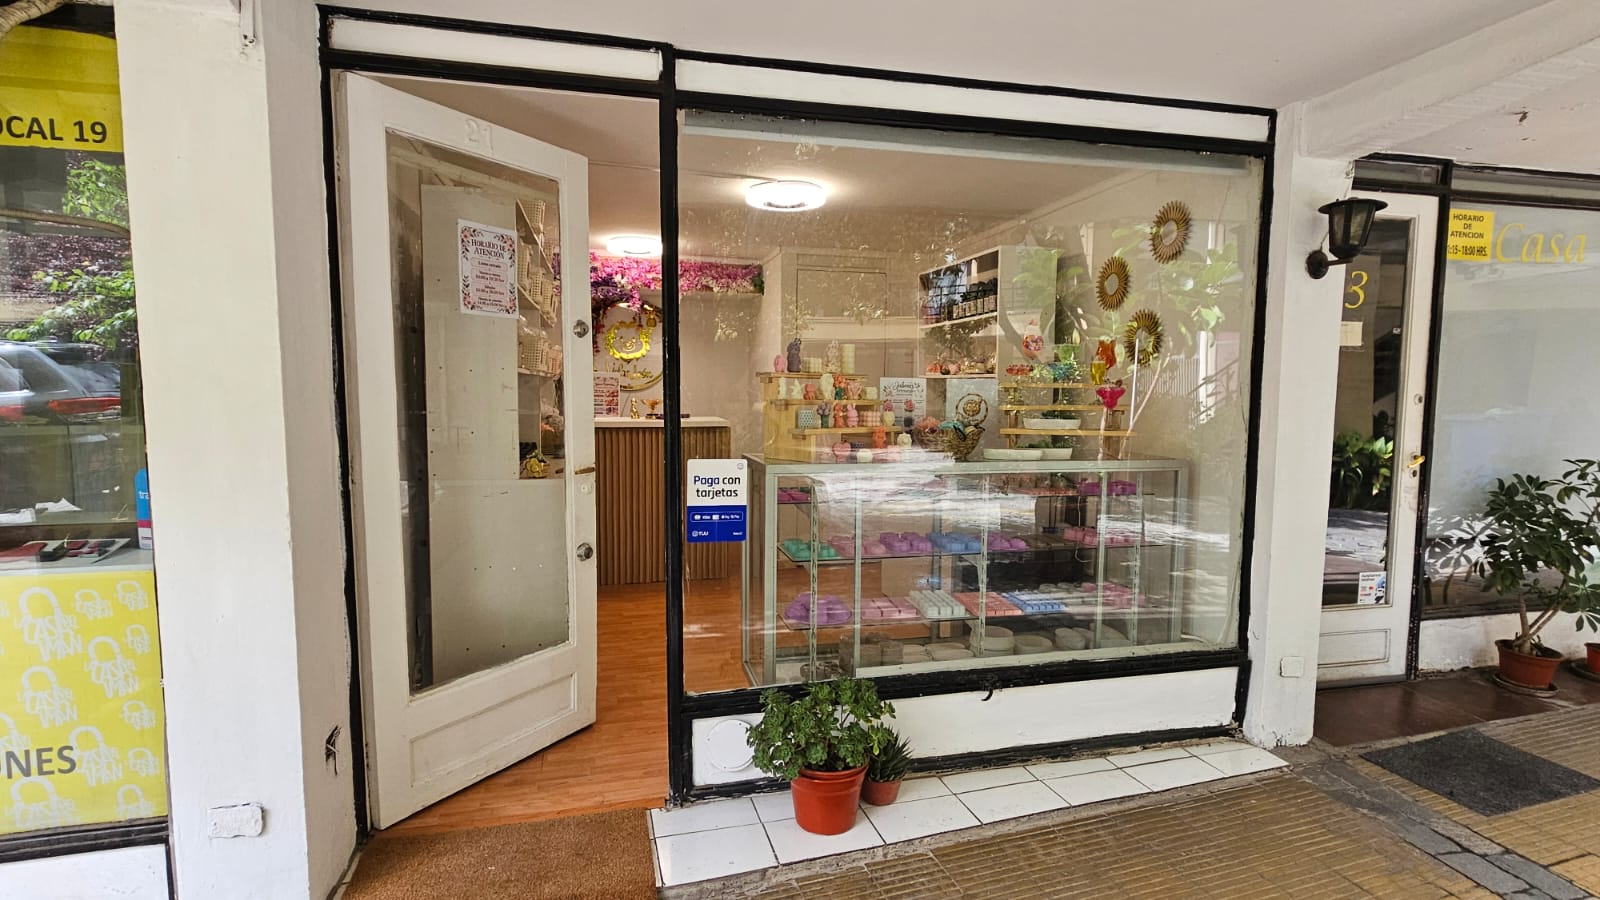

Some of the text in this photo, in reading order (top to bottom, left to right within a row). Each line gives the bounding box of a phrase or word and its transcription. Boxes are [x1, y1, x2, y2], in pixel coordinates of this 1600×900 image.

[0, 115, 108, 144] CAL 19
[1453, 213, 1485, 223] HORARIO
[1463, 222, 1473, 230] DE
[1450, 230, 1485, 239] ATENCION
[1495, 223, 1587, 264] Casa
[1344, 270, 1369, 309] 3
[693, 475, 741, 487] Paga con
[696, 488, 738, 500] tarjetas
[0, 745, 77, 779] NES
